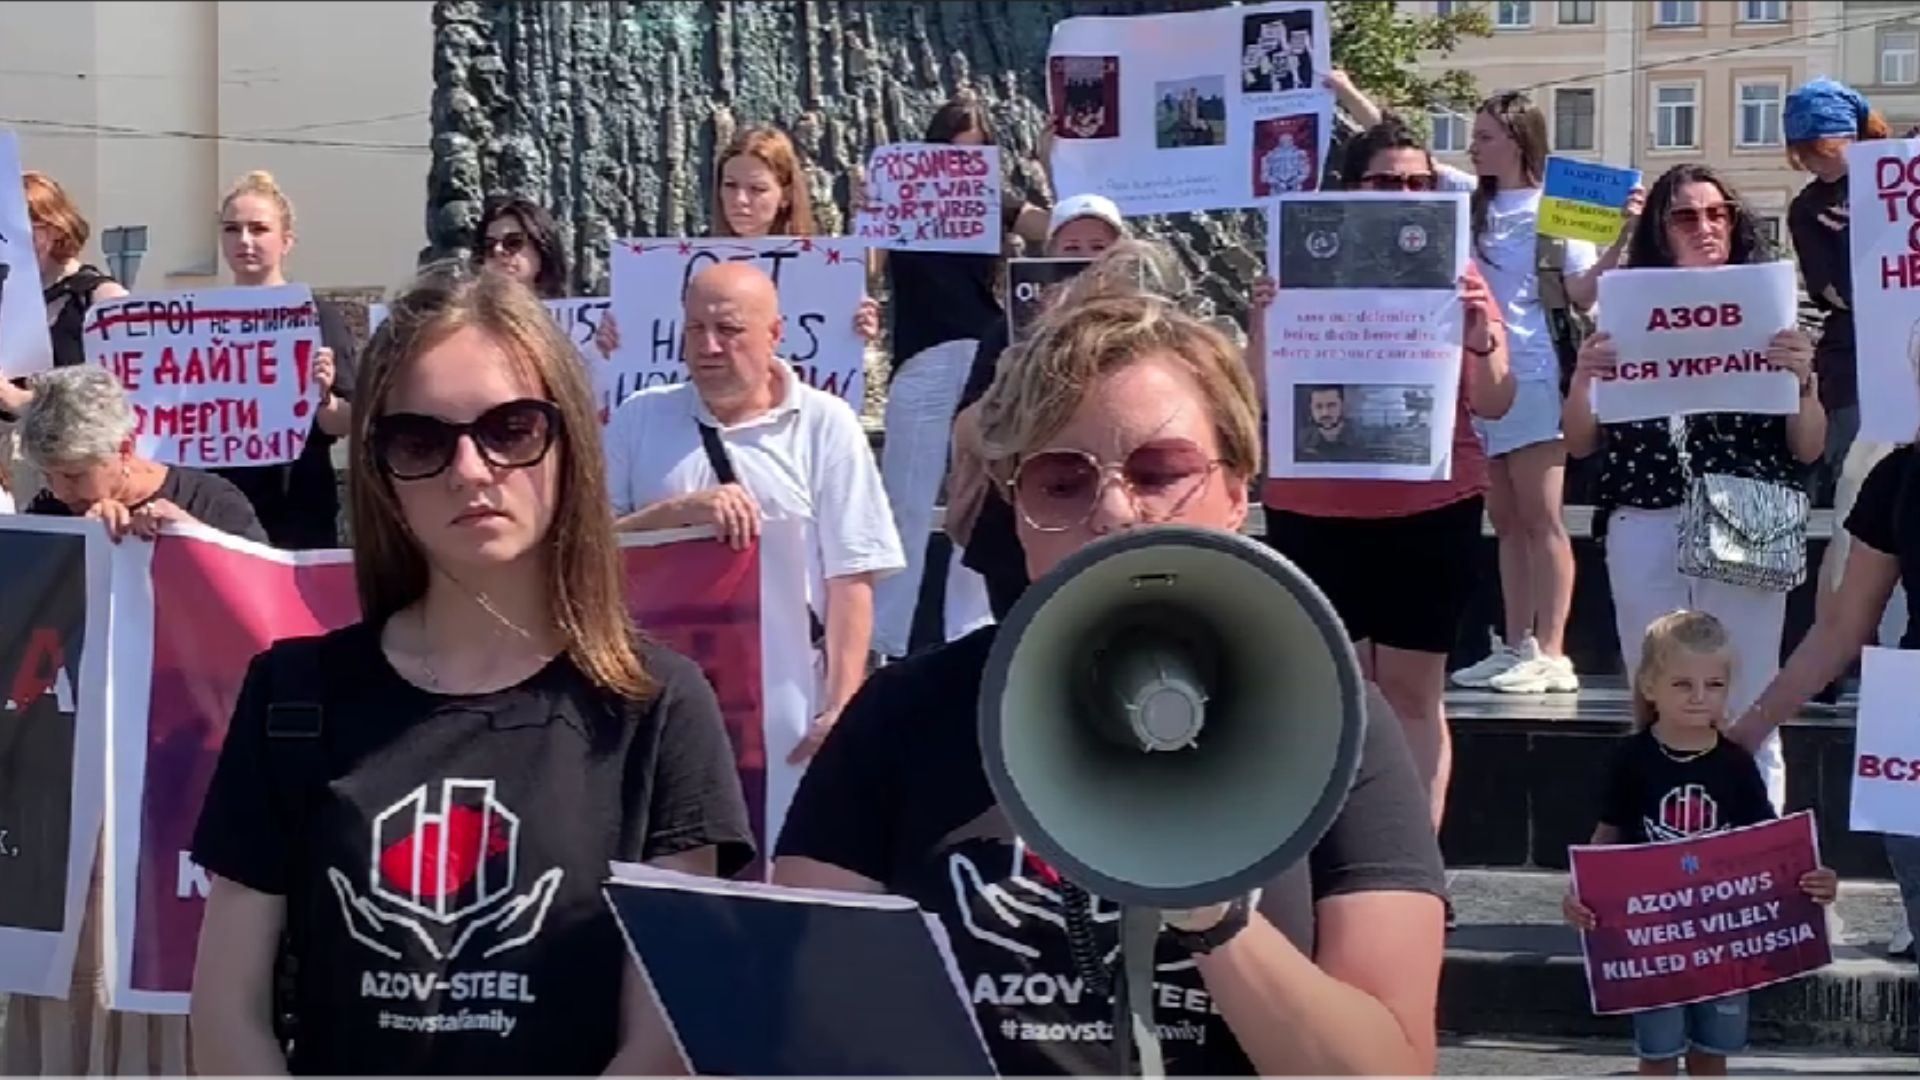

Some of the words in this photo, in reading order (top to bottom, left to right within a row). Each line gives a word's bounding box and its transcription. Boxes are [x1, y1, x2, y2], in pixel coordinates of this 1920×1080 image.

[1646, 303, 1743, 331] АЗОВ
[1626, 887, 1693, 915] AZOV
[1625, 926, 1697, 947] WERE
[1700, 901, 1780, 933] VILELY
[1602, 953, 1686, 981] KILLED
[1693, 945, 1724, 968] BY
[1730, 923, 1816, 959] RUSSIA
[361, 971, 535, 1002] AZOV-STEEL
